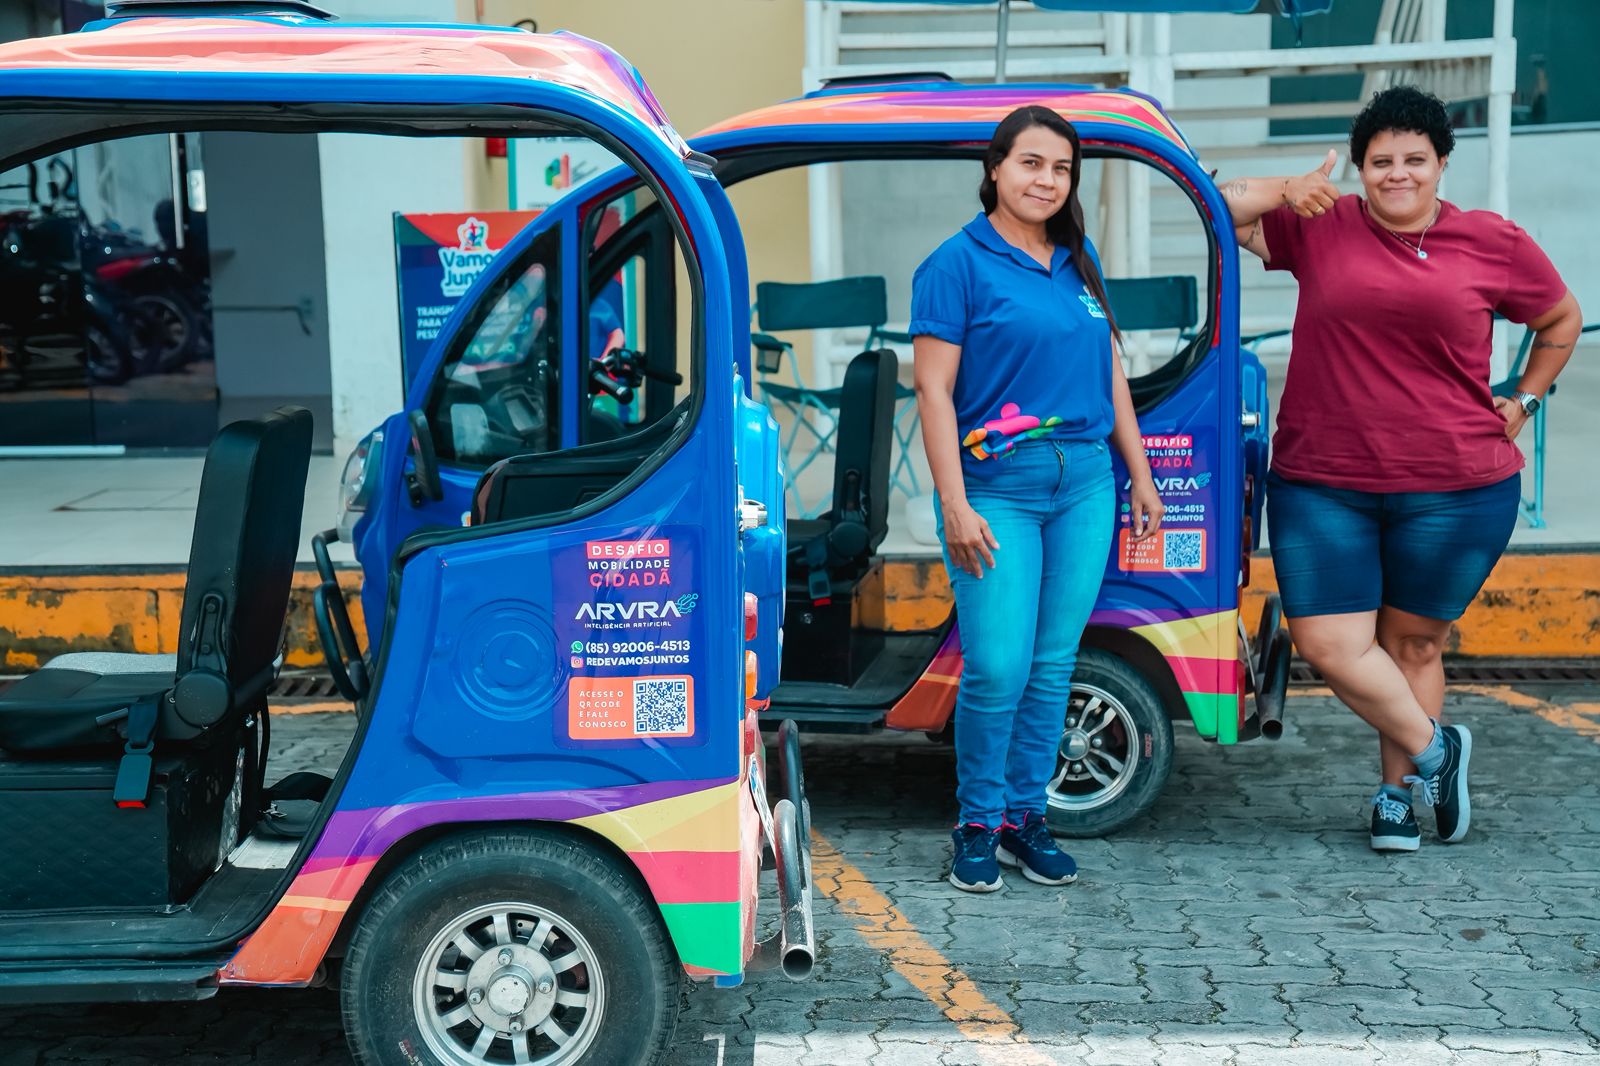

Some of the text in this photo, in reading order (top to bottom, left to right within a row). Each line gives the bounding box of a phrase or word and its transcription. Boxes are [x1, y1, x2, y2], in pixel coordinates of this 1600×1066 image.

[443, 252, 494, 267] Vamo
[417, 318, 441, 328] PARA
[1145, 448, 1192, 457] OBILIDADE
[592, 543, 665, 556] DESAFIO
[588, 559, 670, 569] MOBILIDADE
[590, 568, 671, 587] CIDADÃ
[575, 600, 682, 620] ARVRA
[586, 640, 690, 654] (85) 92006-4513
[587, 655, 689, 665] REDEVAMOSJUNTOS
[594, 700, 621, 708] CODE
